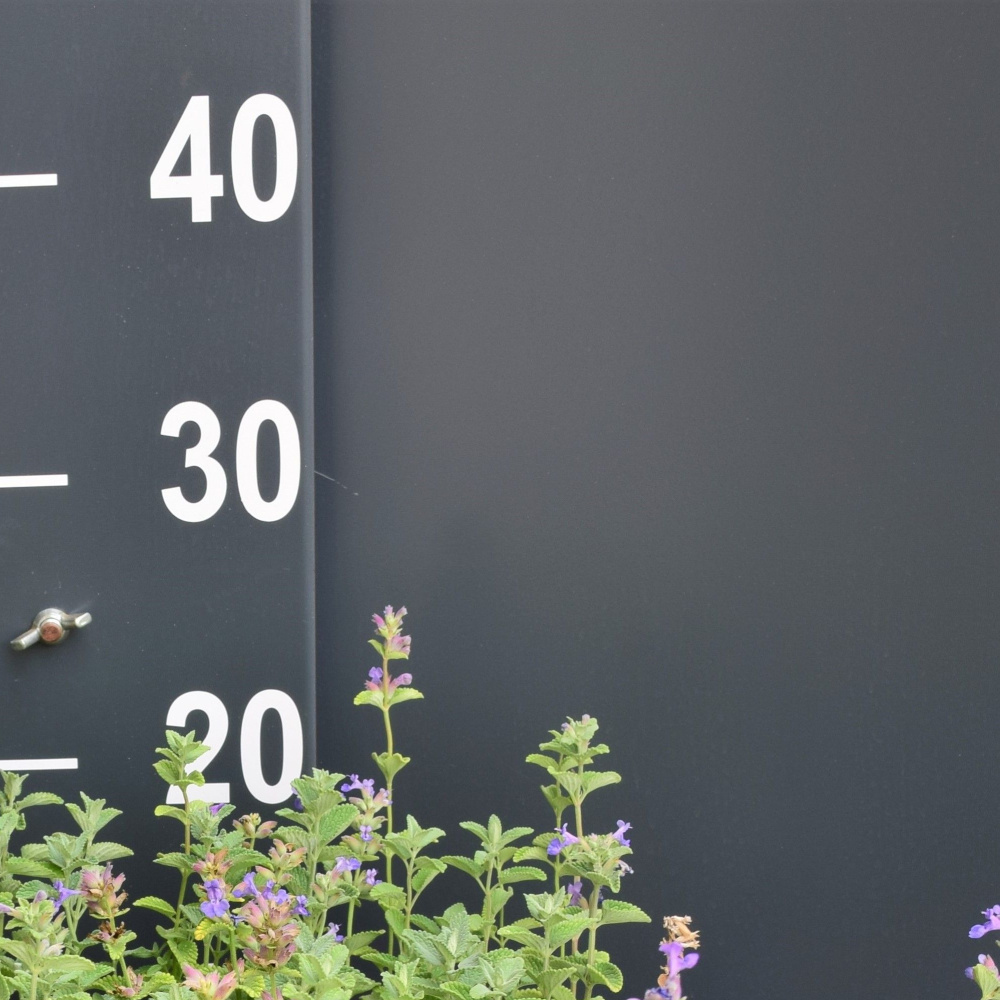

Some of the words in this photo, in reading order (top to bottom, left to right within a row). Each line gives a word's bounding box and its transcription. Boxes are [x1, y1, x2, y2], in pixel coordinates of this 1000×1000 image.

[150, 93, 298, 222] 40
[160, 399, 301, 522] 30
[165, 689, 303, 805] 20
